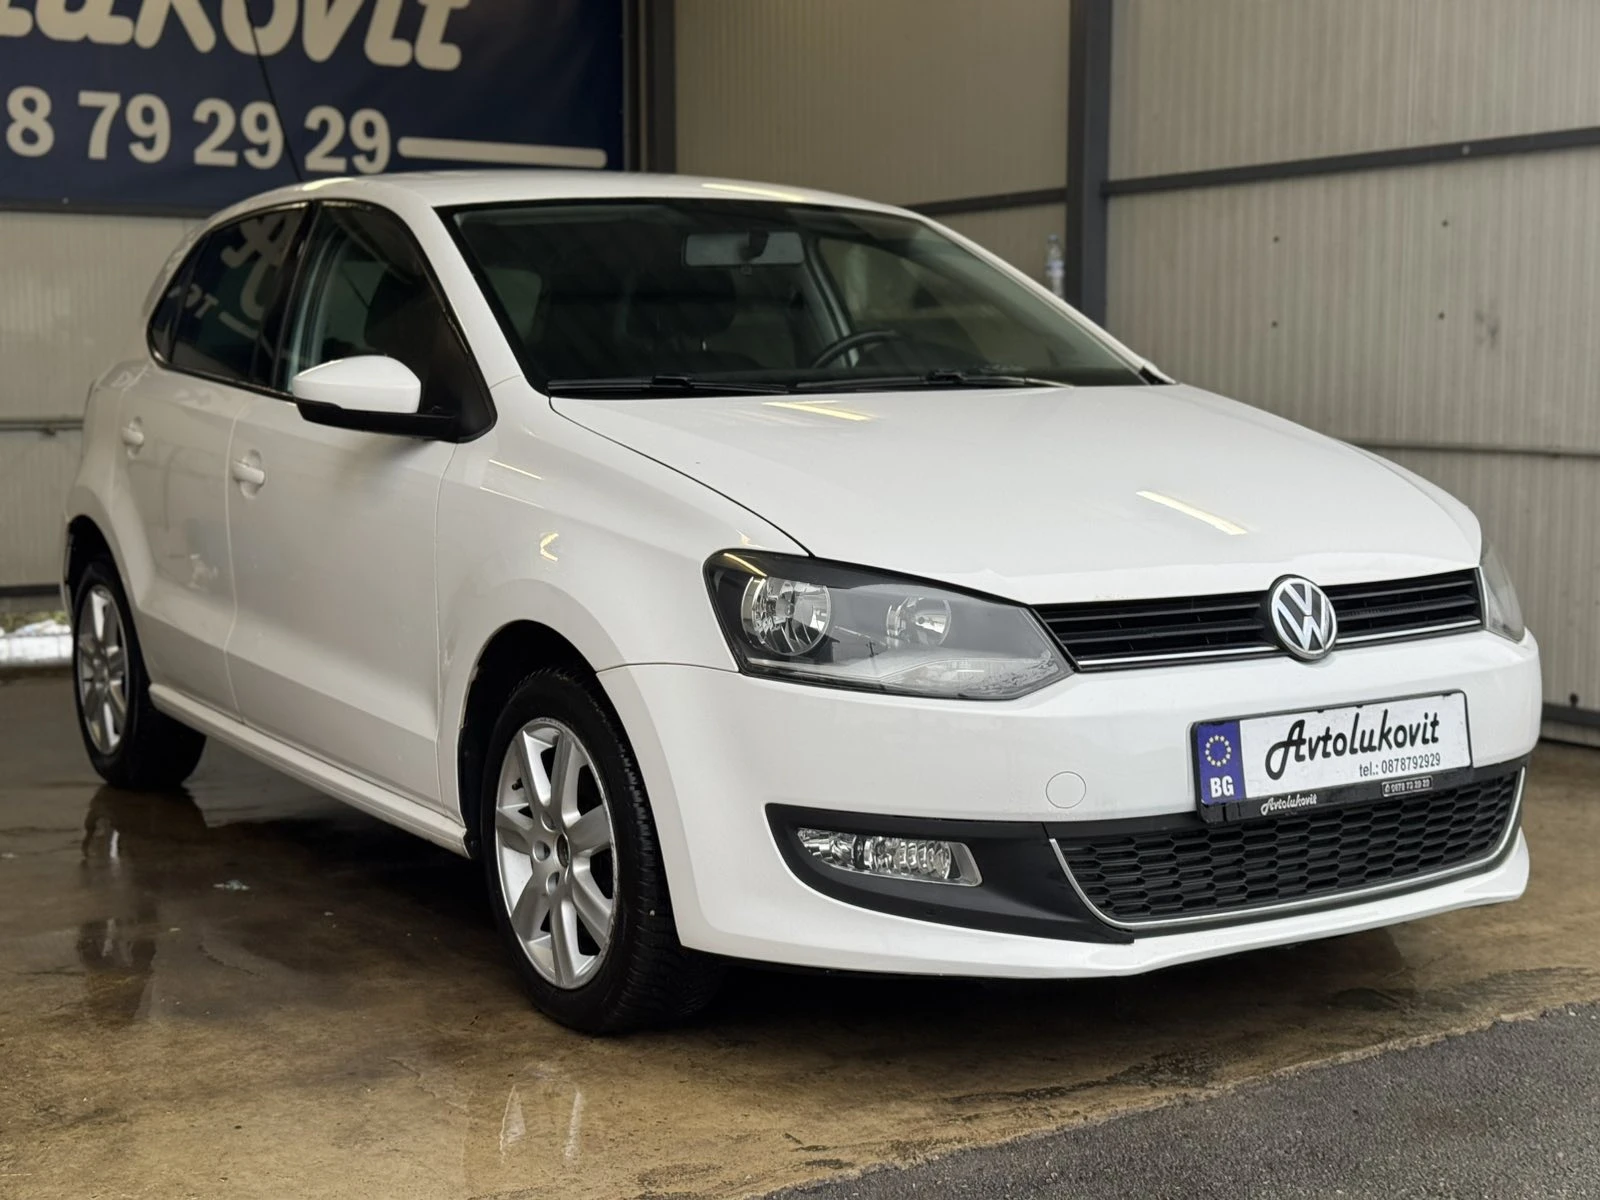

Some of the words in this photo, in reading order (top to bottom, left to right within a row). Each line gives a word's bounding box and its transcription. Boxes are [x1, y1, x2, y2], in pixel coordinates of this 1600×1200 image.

[6, 86, 55, 157] 8
[78, 90, 171, 163] 79
[193, 98, 284, 169] 29
[304, 105, 391, 174] 29
[1265, 709, 1440, 780] Avtolukovit
[1359, 761, 1379, 777] tel.:
[1381, 752, 1441, 774] 0878792929
[1210, 775, 1235, 799] BG
[1260, 793, 1317, 816] Avtolukovit
